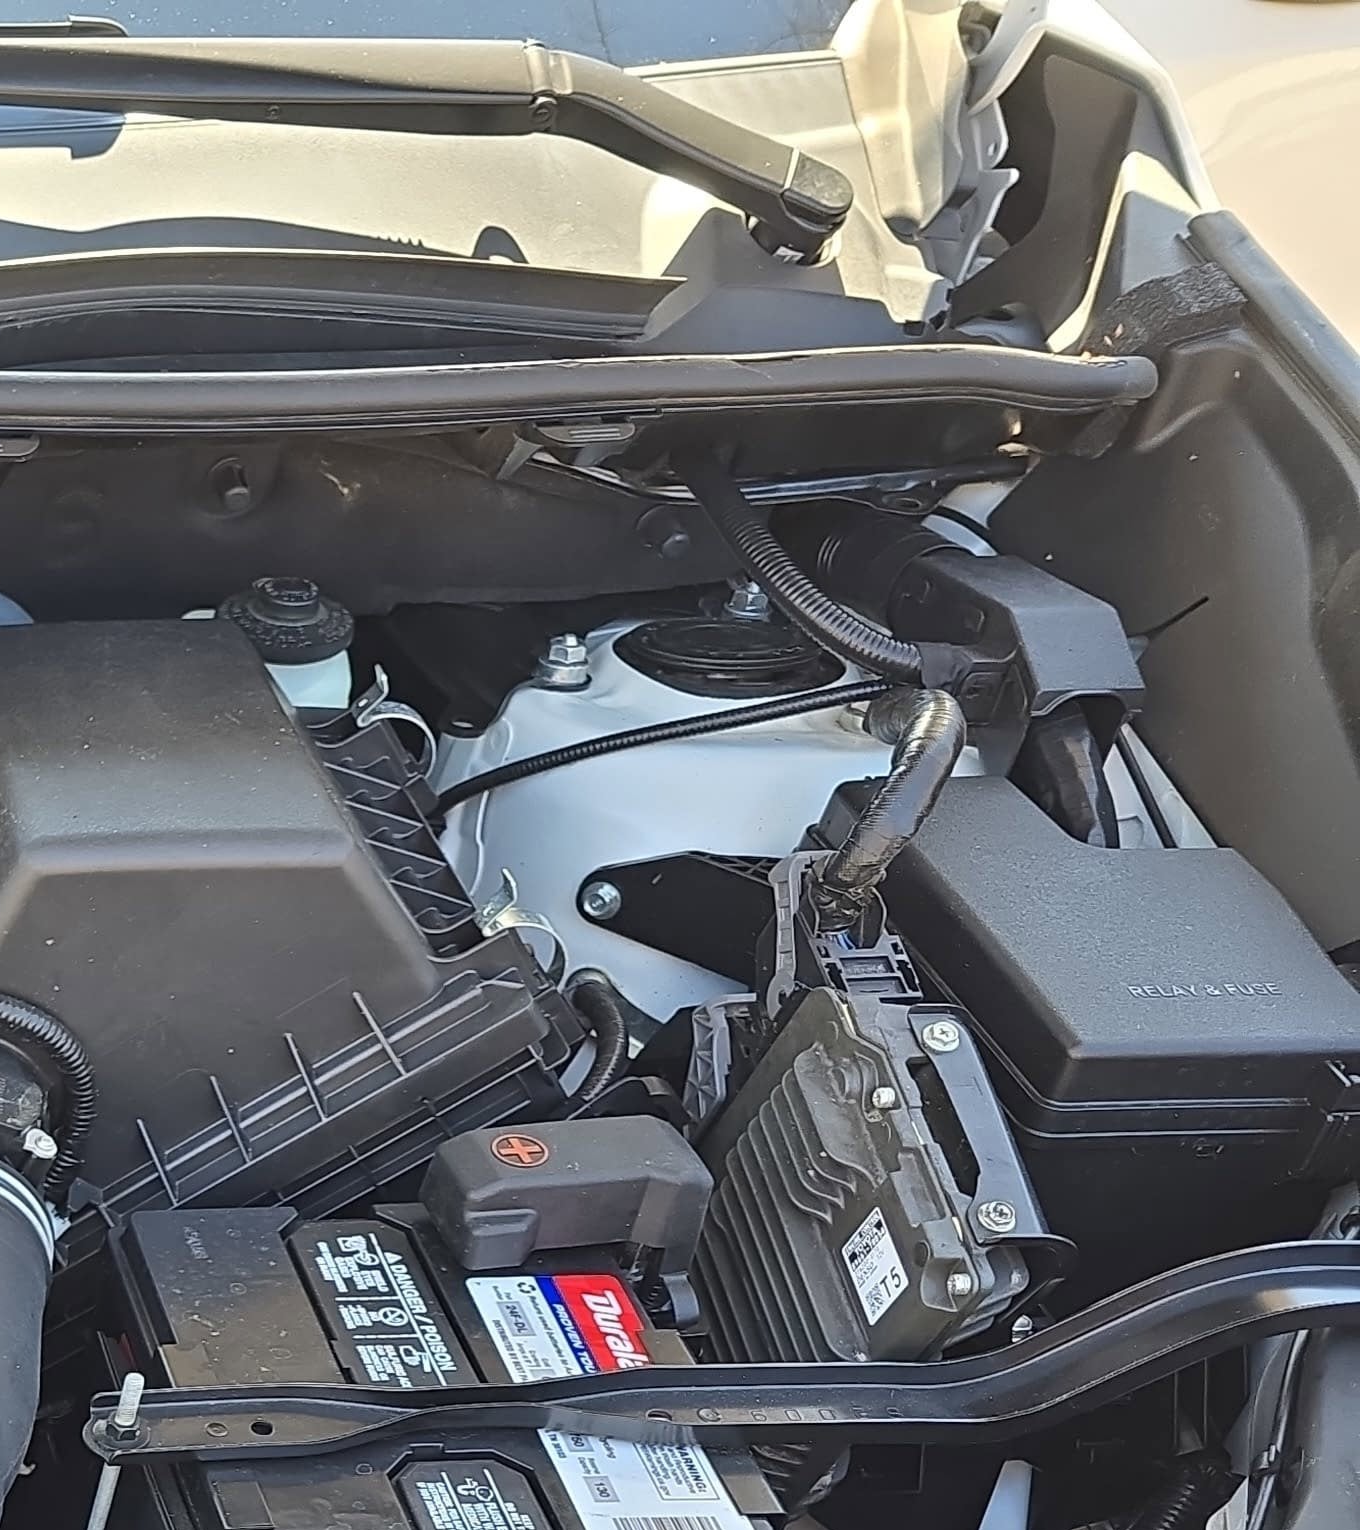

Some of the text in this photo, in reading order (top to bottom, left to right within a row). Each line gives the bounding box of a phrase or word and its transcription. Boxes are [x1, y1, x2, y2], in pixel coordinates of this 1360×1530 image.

[1127, 981, 1283, 999] RELAY & FUSE
[388, 1264, 429, 1313] DANGER
[419, 1325, 457, 1370] POISON
[504, 1304, 529, 1333] 24F-DL
[538, 1316, 552, 1330] used
[551, 1303, 583, 1347] PROVEN
[592, 1482, 612, 1497] 130
[483, 1502, 506, 1524] FLUSH
